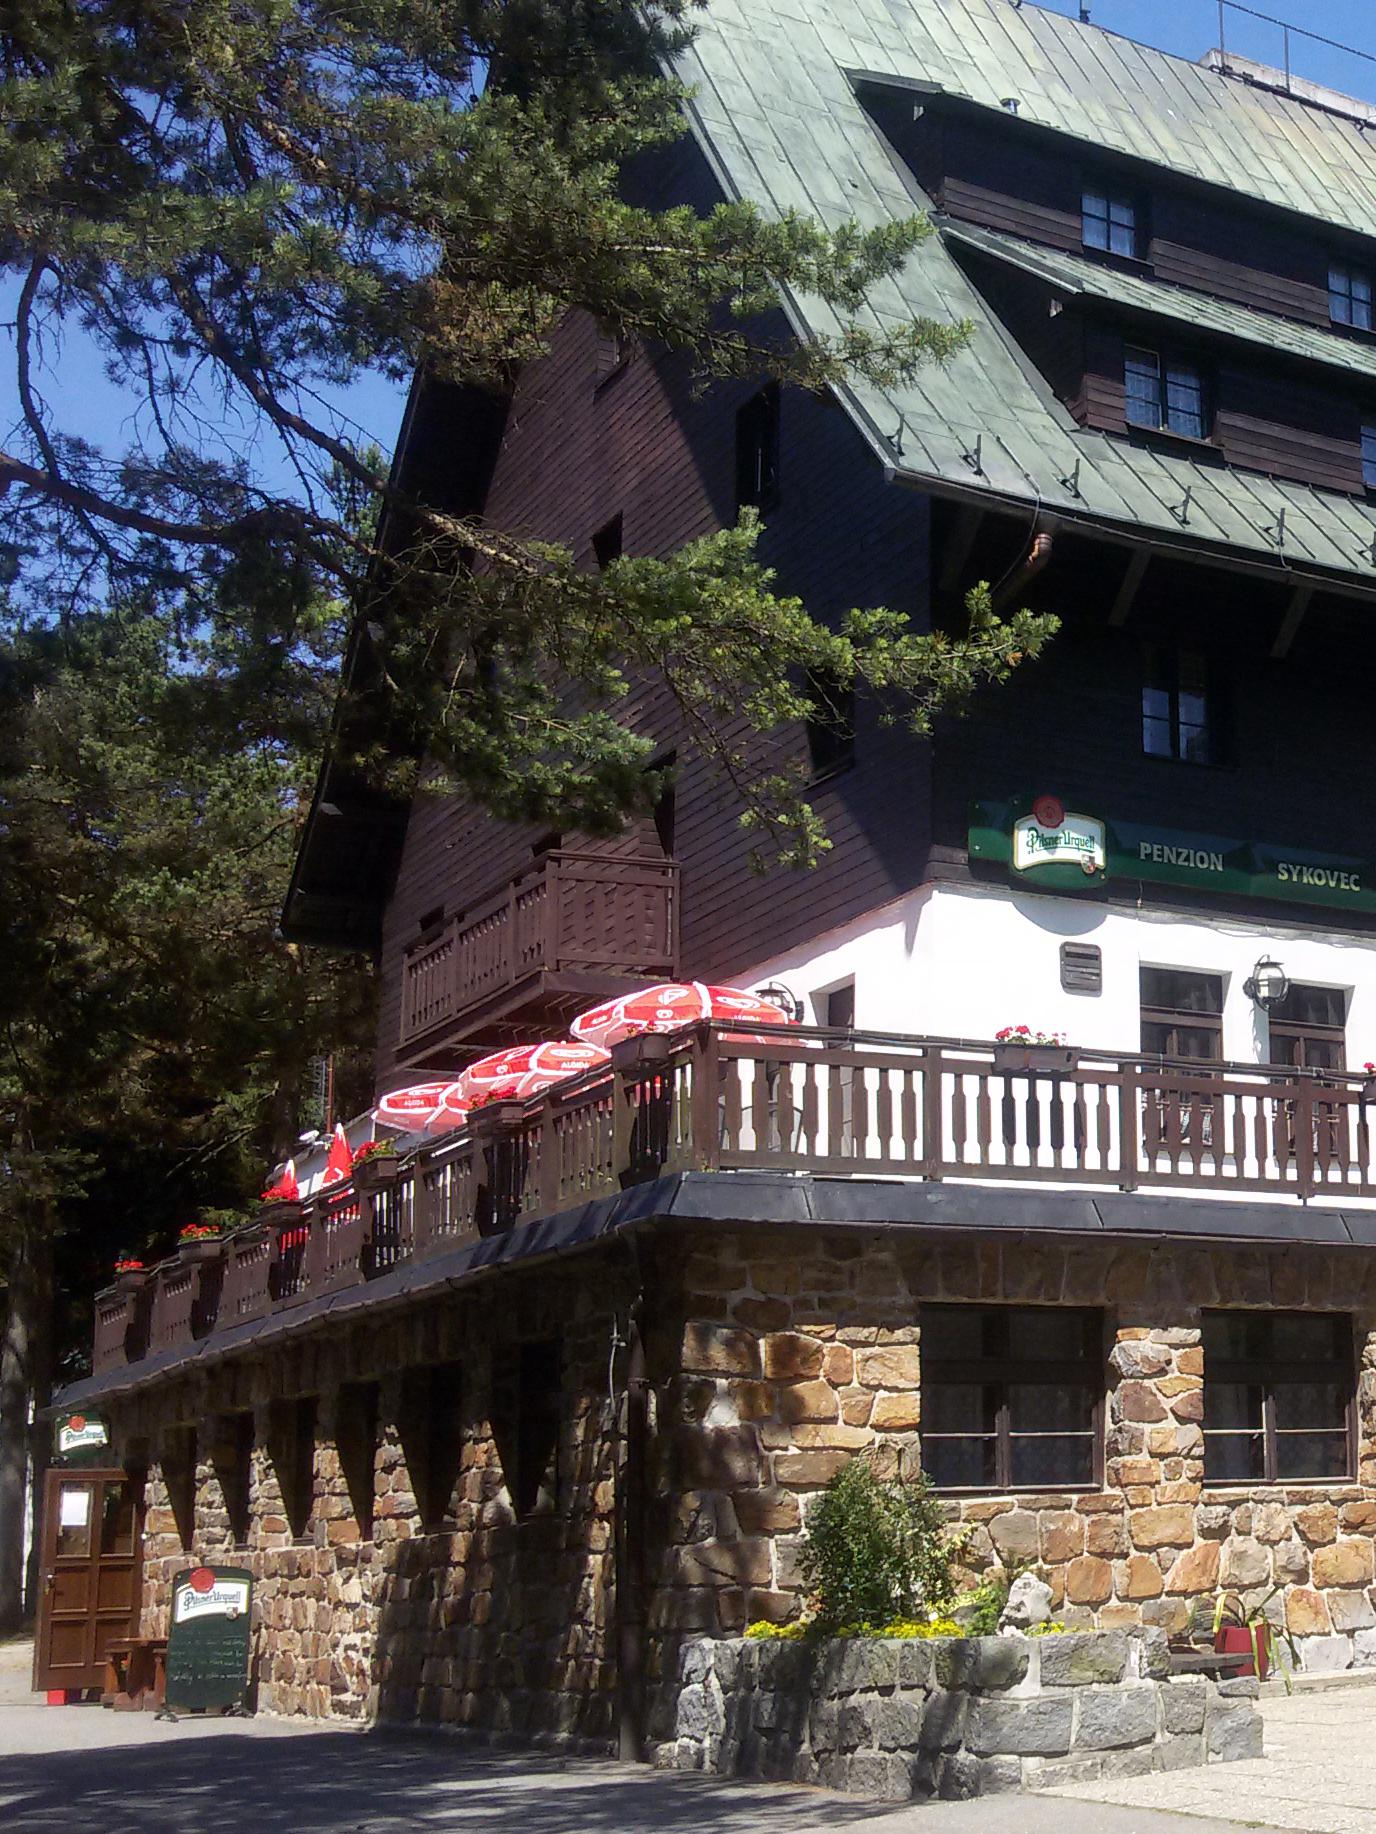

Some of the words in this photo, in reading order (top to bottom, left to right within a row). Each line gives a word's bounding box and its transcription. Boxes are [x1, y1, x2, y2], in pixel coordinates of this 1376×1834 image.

[1026, 827, 1062, 854] Pilsner
[1062, 831, 1095, 852] Urquell
[1139, 841, 1224, 871] PENZION
[1277, 862, 1361, 891] SYKOVEC
[183, 1591, 213, 1611] Pilsner
[213, 1590, 241, 1604] Urquell
